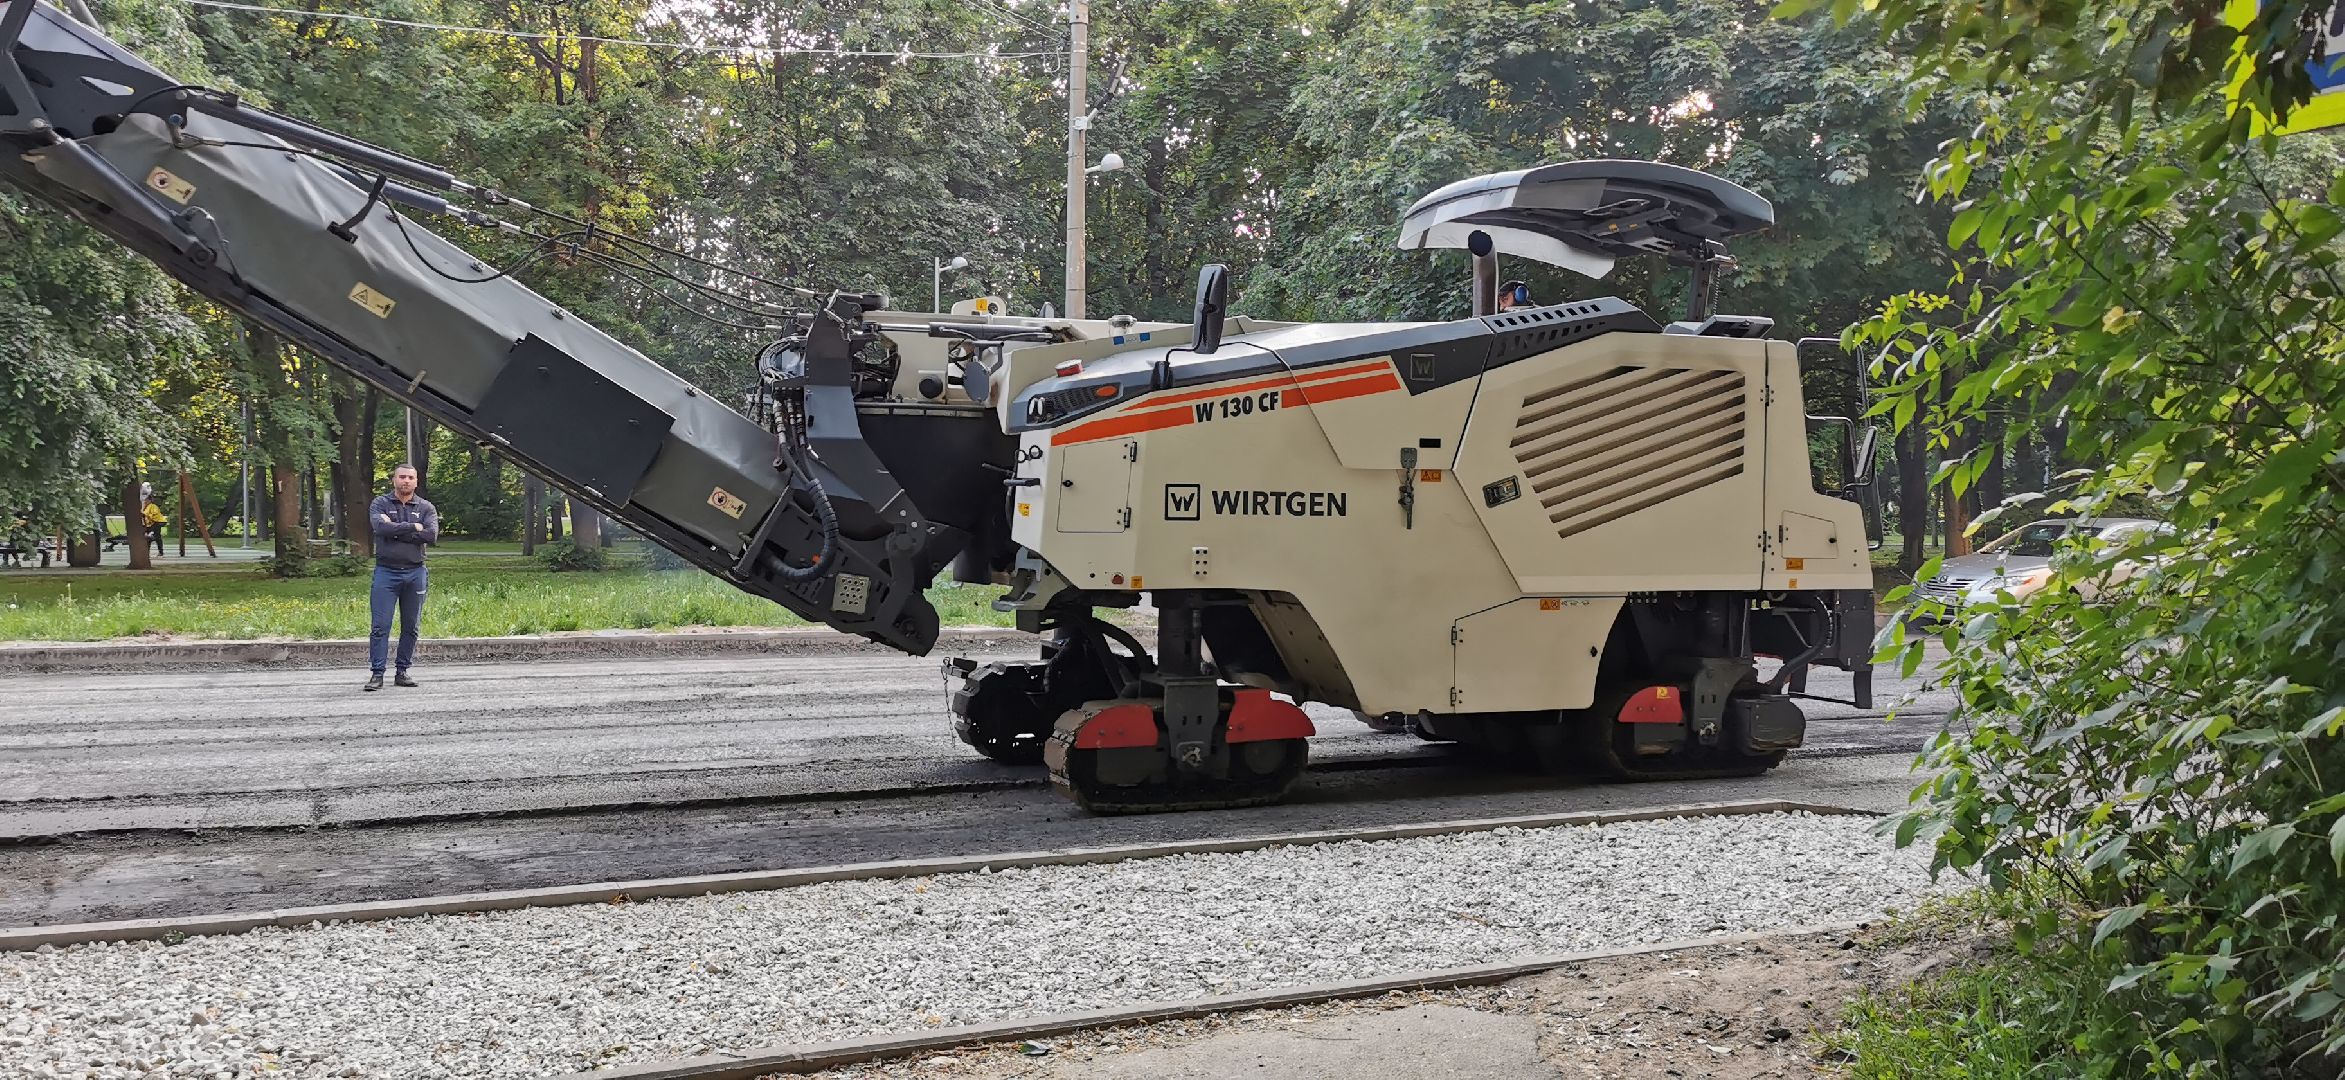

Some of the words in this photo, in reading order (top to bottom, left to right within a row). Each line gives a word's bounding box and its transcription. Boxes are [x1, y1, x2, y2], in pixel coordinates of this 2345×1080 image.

[1195, 401, 1214, 423] W
[1220, 395, 1253, 419] 130
[1258, 391, 1279, 413] CF
[1170, 492, 1195, 512] W
[1211, 490, 1347, 517] WIRTGEN
